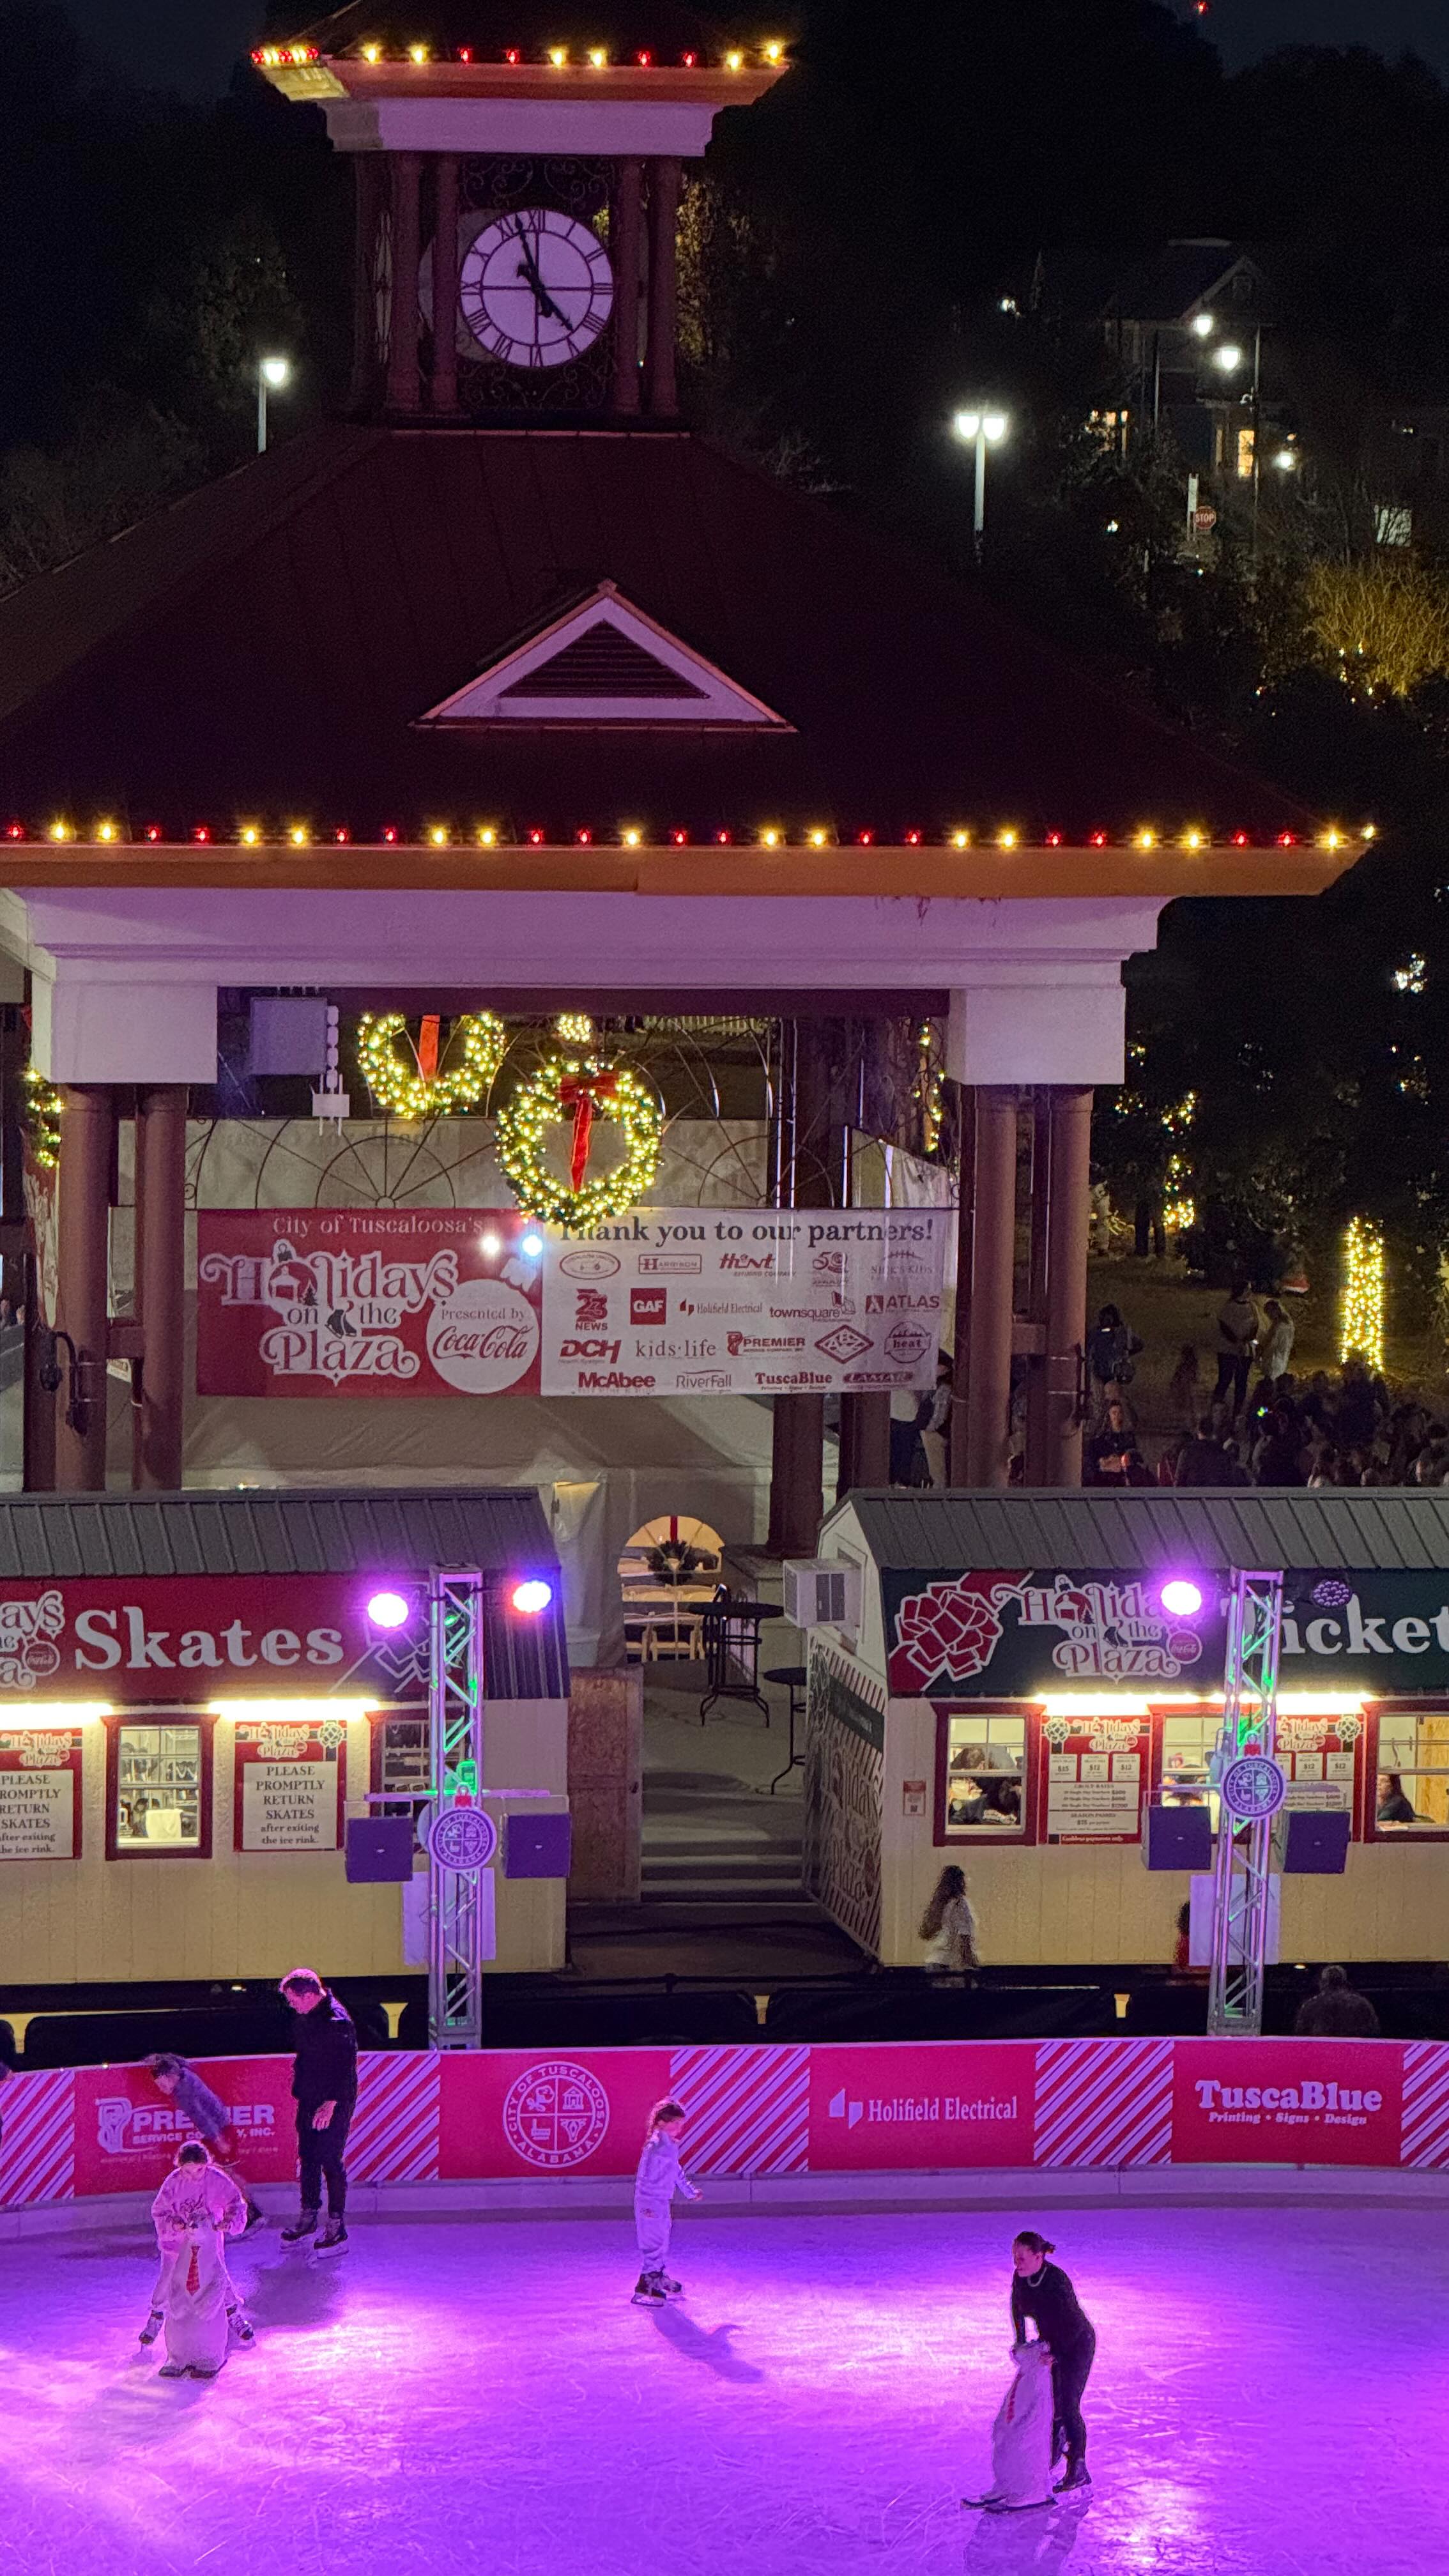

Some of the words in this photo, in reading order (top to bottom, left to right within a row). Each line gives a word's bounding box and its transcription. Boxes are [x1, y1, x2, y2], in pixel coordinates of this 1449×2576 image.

[1195, 513, 1215, 523] STOP
[273, 1215, 309, 1237] City
[320, 1215, 344, 1234] of
[348, 1215, 484, 1234] Tuscaloosa's
[657, 1225, 705, 1247] you
[714, 1221, 742, 1241] to
[753, 1224, 801, 1241] our
[808, 1218, 933, 1248] partners!
[201, 1251, 457, 1309] Holidays
[633, 1300, 664, 1313] GAF
[886, 1295, 940, 1310] ATLAS
[288, 1307, 318, 1326] on
[358, 1302, 397, 1325] the
[441, 1308, 506, 1321] Presented
[510, 1308, 525, 1322] by
[770, 1307, 840, 1321] townsquare
[575, 1322, 608, 1331] NEWS
[742, 1337, 806, 1347] PREMIER
[263, 1328, 417, 1374] Plaza
[559, 1339, 622, 1364] DCH
[578, 1372, 656, 1388] McAbee
[755, 1371, 832, 1385] TuscaBlue
[1073, 1623, 1097, 1639] on
[1128, 1621, 1160, 1639] the
[75, 1606, 344, 1670] Skates
[1057, 1644, 1181, 1675] Plaza
[266, 1766, 315, 1776] PLEASE
[1, 1774, 50, 1785] PLEASE
[256, 1780, 325, 1790] PROMPTLY
[263, 1795, 314, 1805] RETURN
[266, 1809, 314, 1820] SKATES
[1, 1818, 50, 1828] SKATES
[287, 1823, 319, 1833] exiting
[22, 1832, 56, 1842] exiting
[280, 1836, 292, 1844] ice
[518, 2076, 533, 2092] OF
[537, 2066, 604, 2129] TUSCALOOSA
[1195, 2080, 1383, 2112] TuscaBlue
[508, 2097, 518, 2131] CITY
[868, 2098, 940, 2122] Holifield
[945, 2096, 1018, 2120] Electrical
[133, 2104, 275, 2132] PREER
[1209, 2111, 1261, 2124] Printing
[1276, 2112, 1309, 2124] Signs
[1324, 2113, 1367, 2126] Design
[132, 2132, 182, 2144] SERVICE
[250, 2127, 275, 2137] INC.
[518, 2140, 594, 2163] ALABAMA
